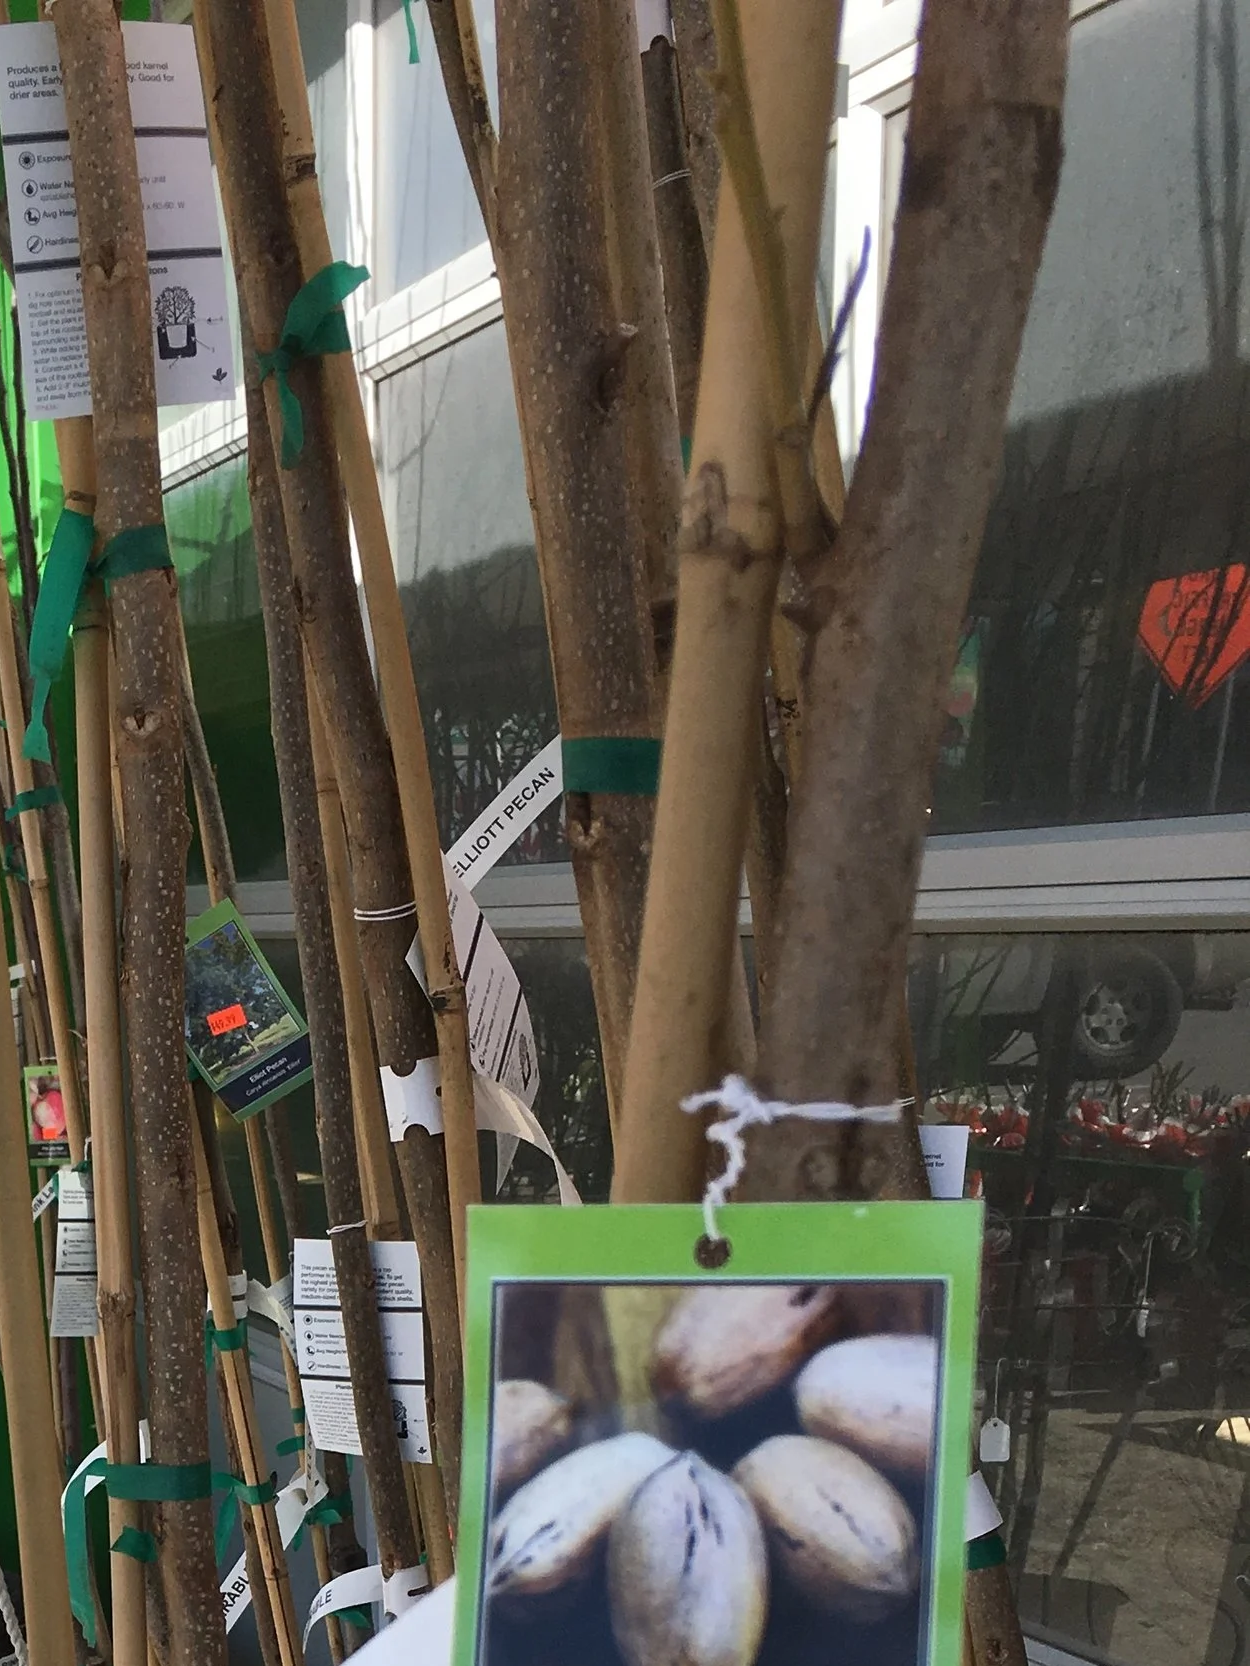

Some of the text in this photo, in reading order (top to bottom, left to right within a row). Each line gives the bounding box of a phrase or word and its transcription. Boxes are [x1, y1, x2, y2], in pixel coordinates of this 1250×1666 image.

[7, 65, 49, 76] Produces
[143, 61, 169, 70] kernel
[8, 75, 40, 89] quality.
[138, 73, 162, 81] Good
[10, 88, 59, 100] drier areas.
[39, 181, 62, 191] Water
[42, 211, 58, 220] Avg
[502, 766, 555, 821] PECAN
